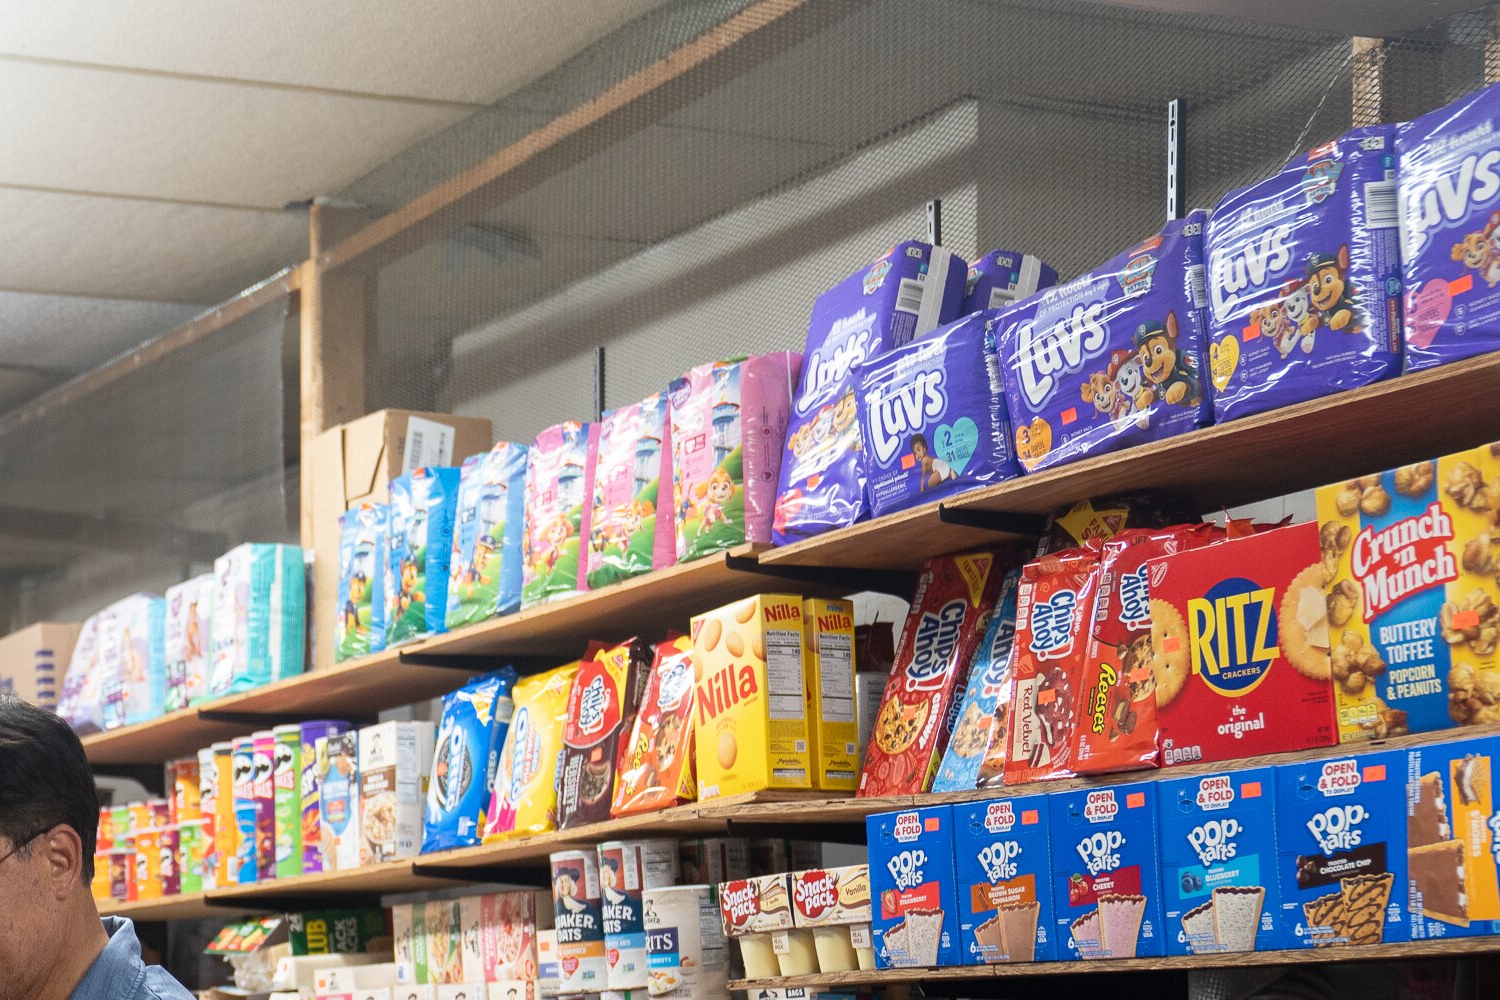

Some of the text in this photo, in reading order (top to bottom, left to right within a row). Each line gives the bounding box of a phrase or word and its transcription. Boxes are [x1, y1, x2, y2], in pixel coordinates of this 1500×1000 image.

[1211, 226, 1290, 322] Luvs
[1016, 303, 1105, 405] Luvs
[865, 370, 944, 464] Luvs
[1353, 503, 1452, 578] Crunch
[1363, 544, 1456, 621] Munch
[764, 603, 801, 623] Nilla
[826, 603, 844, 613] mini
[1050, 590, 1078, 645] Chips
[817, 614, 852, 633] Nilla
[1187, 586, 1281, 676] RITZ
[1380, 617, 1438, 645] BUTTERY
[932, 600, 968, 676] Chips
[1386, 639, 1433, 665] TOFFEE
[1222, 666, 1261, 680] CRACKERS
[1389, 664, 1436, 685] POPCORN
[696, 663, 759, 727] Nilla
[1092, 662, 1118, 735] Reese's
[1396, 679, 1442, 699] PEANUTS
[1021, 684, 1035, 756] Red Velvet
[1232, 705, 1247, 716] the
[1217, 713, 1265, 739] original
[510, 706, 530, 802] OREO
[1324, 762, 1355, 776] OPEN
[1202, 778, 1229, 791] OPEN
[1331, 774, 1359, 788] FOLD
[1088, 792, 1113, 804] OPEN
[1207, 790, 1233, 803] FOLD
[897, 814, 918, 826] OPEN
[988, 804, 1011, 815] OPEN
[993, 814, 1015, 826] FOLD
[1094, 803, 1117, 815] FOLD
[902, 824, 921, 835] FOLD
[1319, 829, 1362, 856] tarts
[1086, 852, 1121, 877] tarts
[1198, 842, 1237, 868] tarts
[987, 861, 1018, 884] tarts
[1205, 869, 1240, 882] BLUEBERRY
[1319, 858, 1372, 875] CHOCOLATE CHIP
[796, 875, 835, 900] Snack
[845, 884, 867, 897] Vanilla
[895, 869, 924, 891] tarts
[1092, 881, 1115, 893] CHERRY
[723, 885, 756, 911] Snack
[988, 885, 1025, 900] BROWN SUGAR
[992, 894, 1021, 905] CINNAMON
[730, 901, 757, 925] pack
[805, 893, 836, 917] pack
[306, 917, 328, 956] LUB
[787, 988, 804, 998] BAGS
